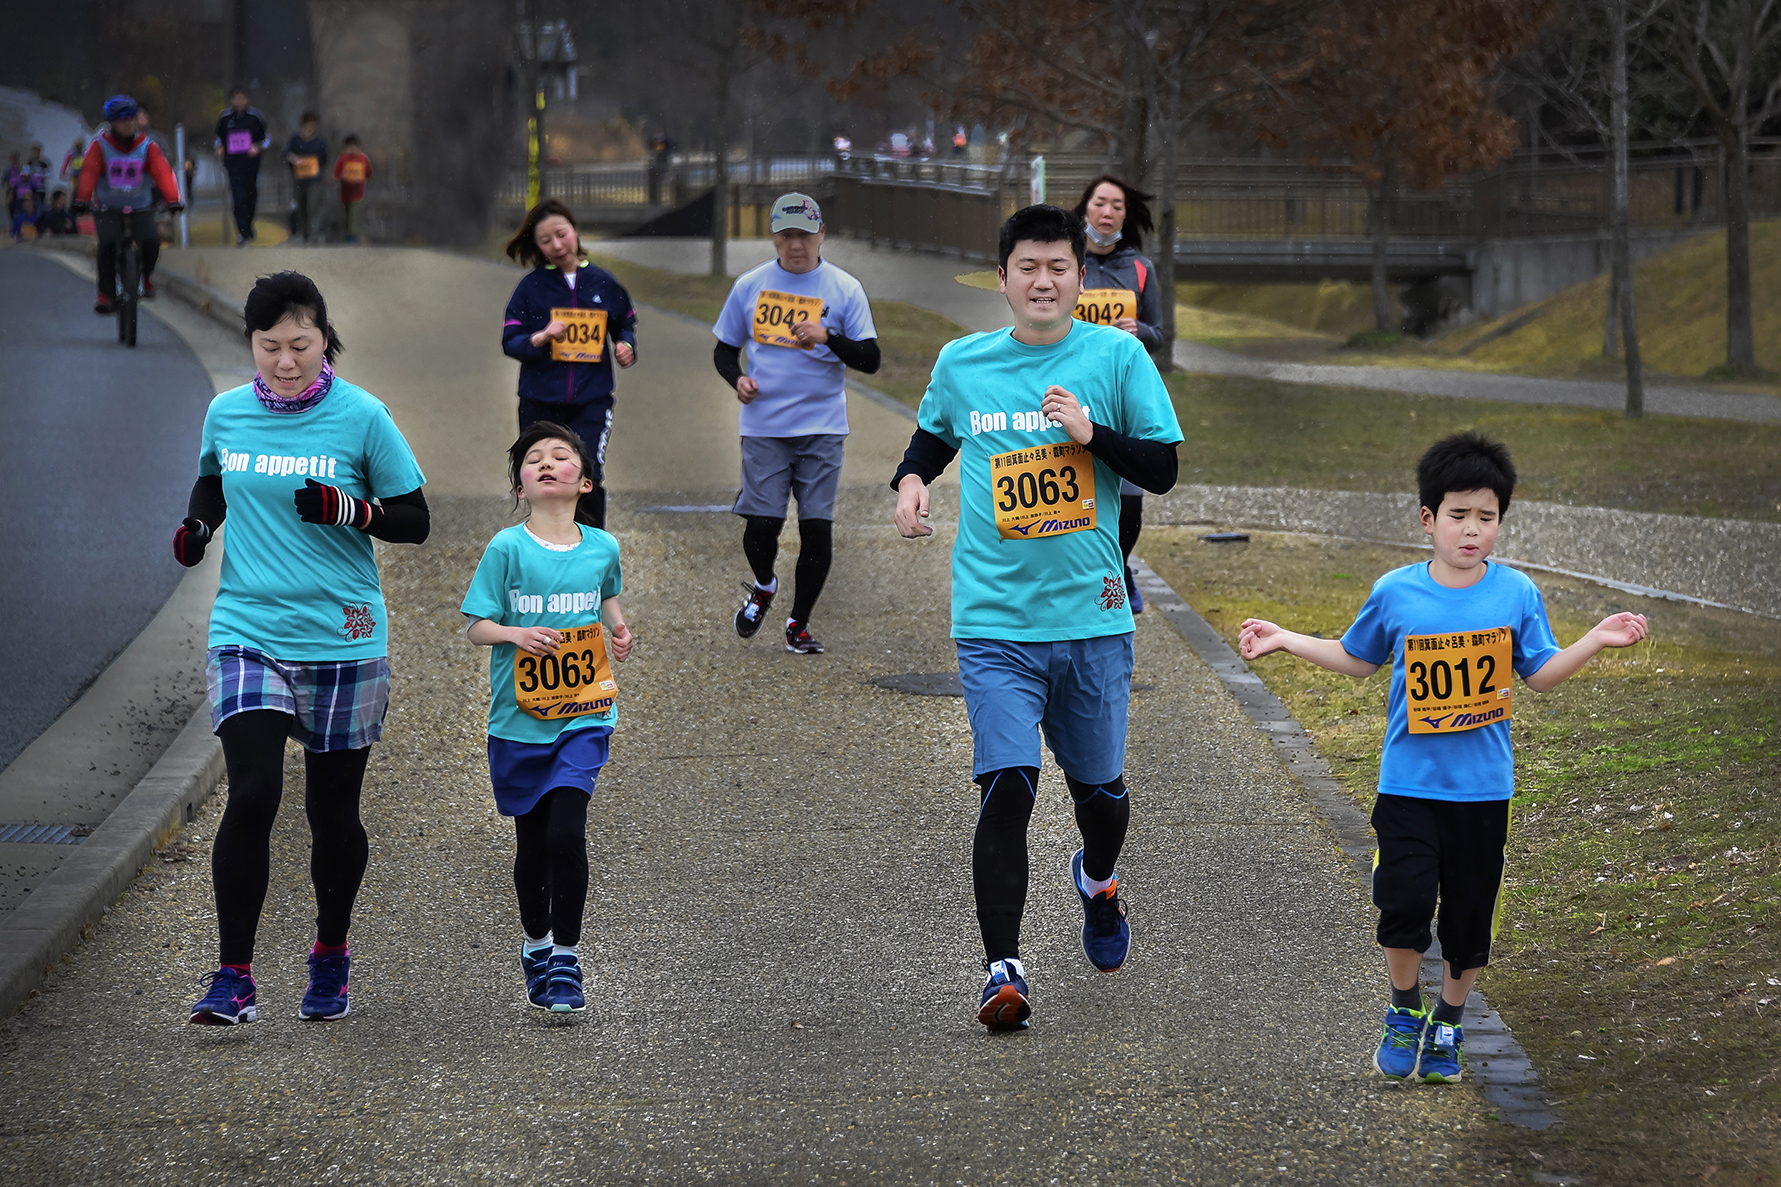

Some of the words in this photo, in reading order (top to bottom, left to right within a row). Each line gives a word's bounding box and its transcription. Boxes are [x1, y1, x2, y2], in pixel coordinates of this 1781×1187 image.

[969, 409, 1007, 436] Bon
[221, 448, 250, 473] Bon
[254, 453, 337, 478] appetit
[997, 466, 1079, 512] 3063
[1038, 517, 1090, 533] MIZUNO
[509, 589, 543, 614] Bon
[518, 649, 596, 692] 3063
[1410, 655, 1496, 701] 3012
[557, 697, 613, 715] MIZUNO
[1450, 707, 1504, 728] MIZUNO
